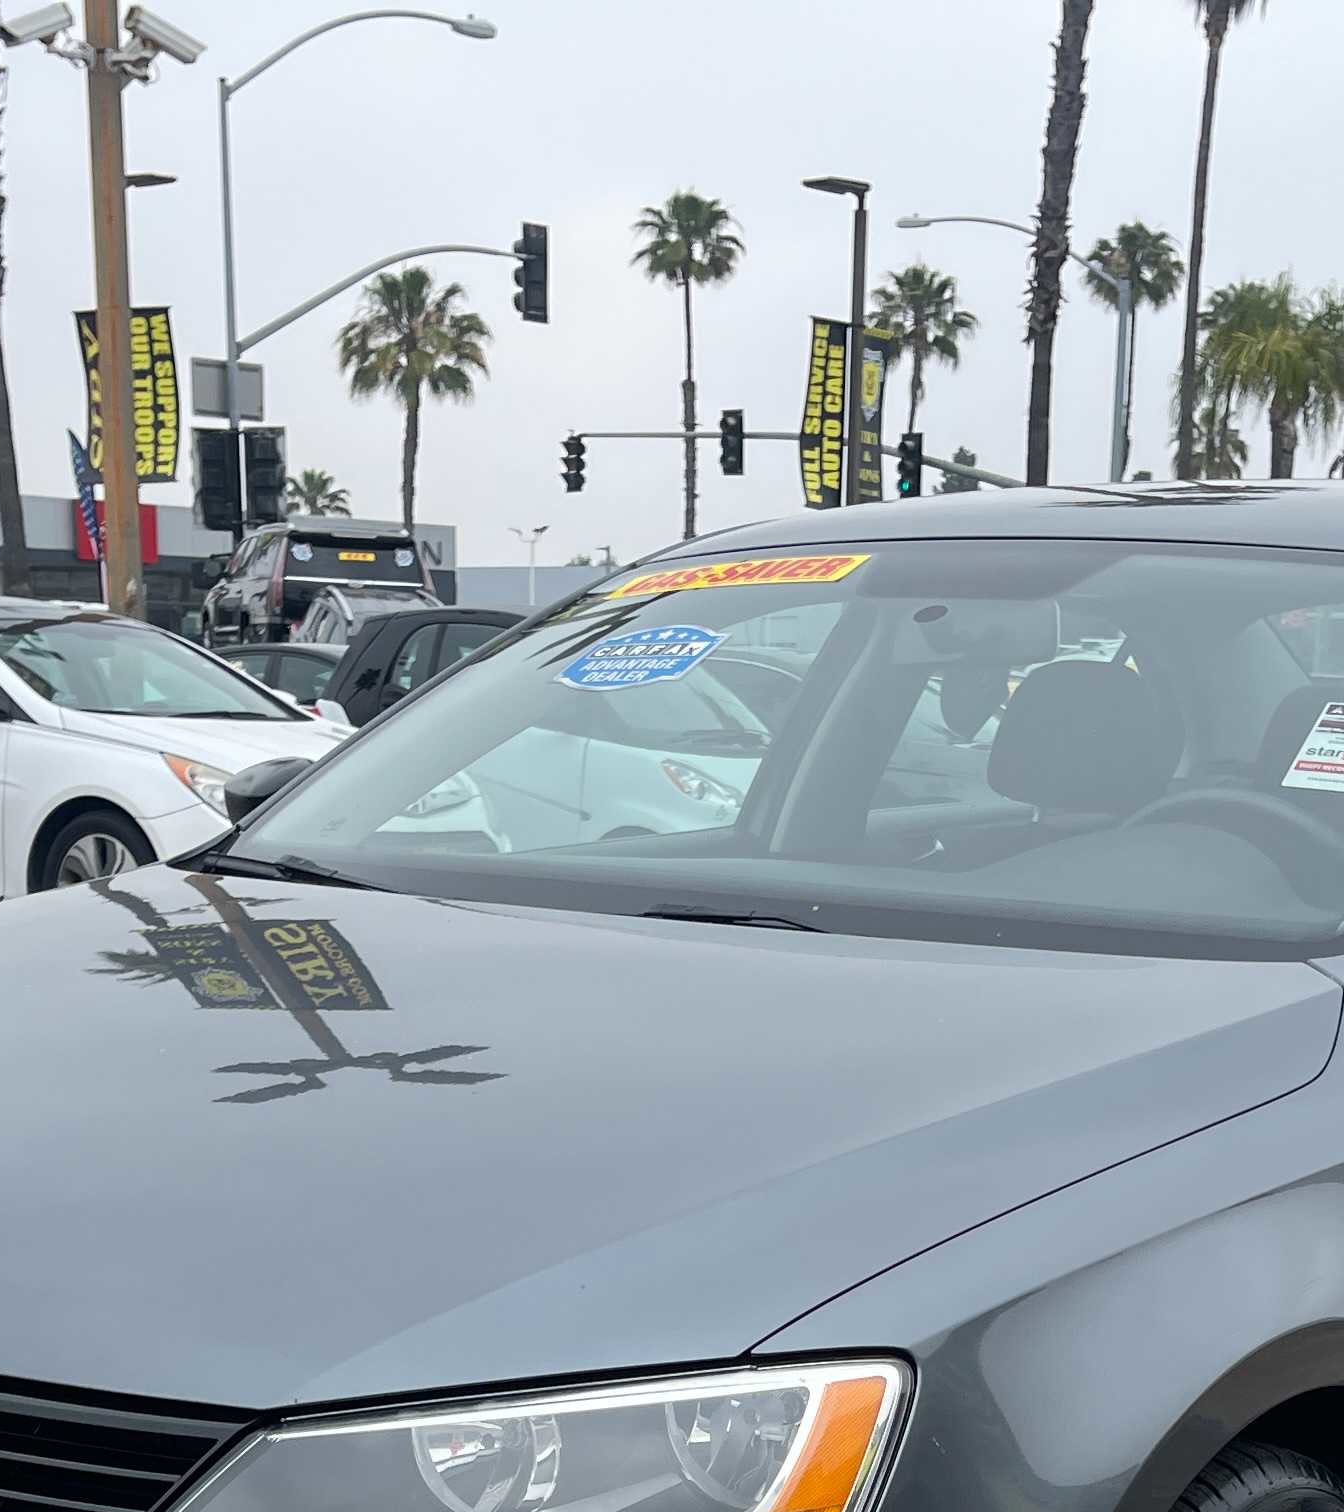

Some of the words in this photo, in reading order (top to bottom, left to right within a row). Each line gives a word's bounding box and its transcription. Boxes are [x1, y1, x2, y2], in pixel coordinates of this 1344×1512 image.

[129, 316, 152, 371] OUR
[149, 313, 171, 355] WE
[803, 323, 831, 435] SERVICE
[822, 344, 845, 414] CARE
[131, 374, 156, 477] TROOPS
[153, 359, 177, 477] SUPPORT
[802, 446, 824, 504] FULL
[821, 418, 843, 490] AUTO
[581, 658, 680, 672] ADVANTAGE
[581, 671, 649, 683] DEALER
[593, 641, 711, 658] CARFAX
